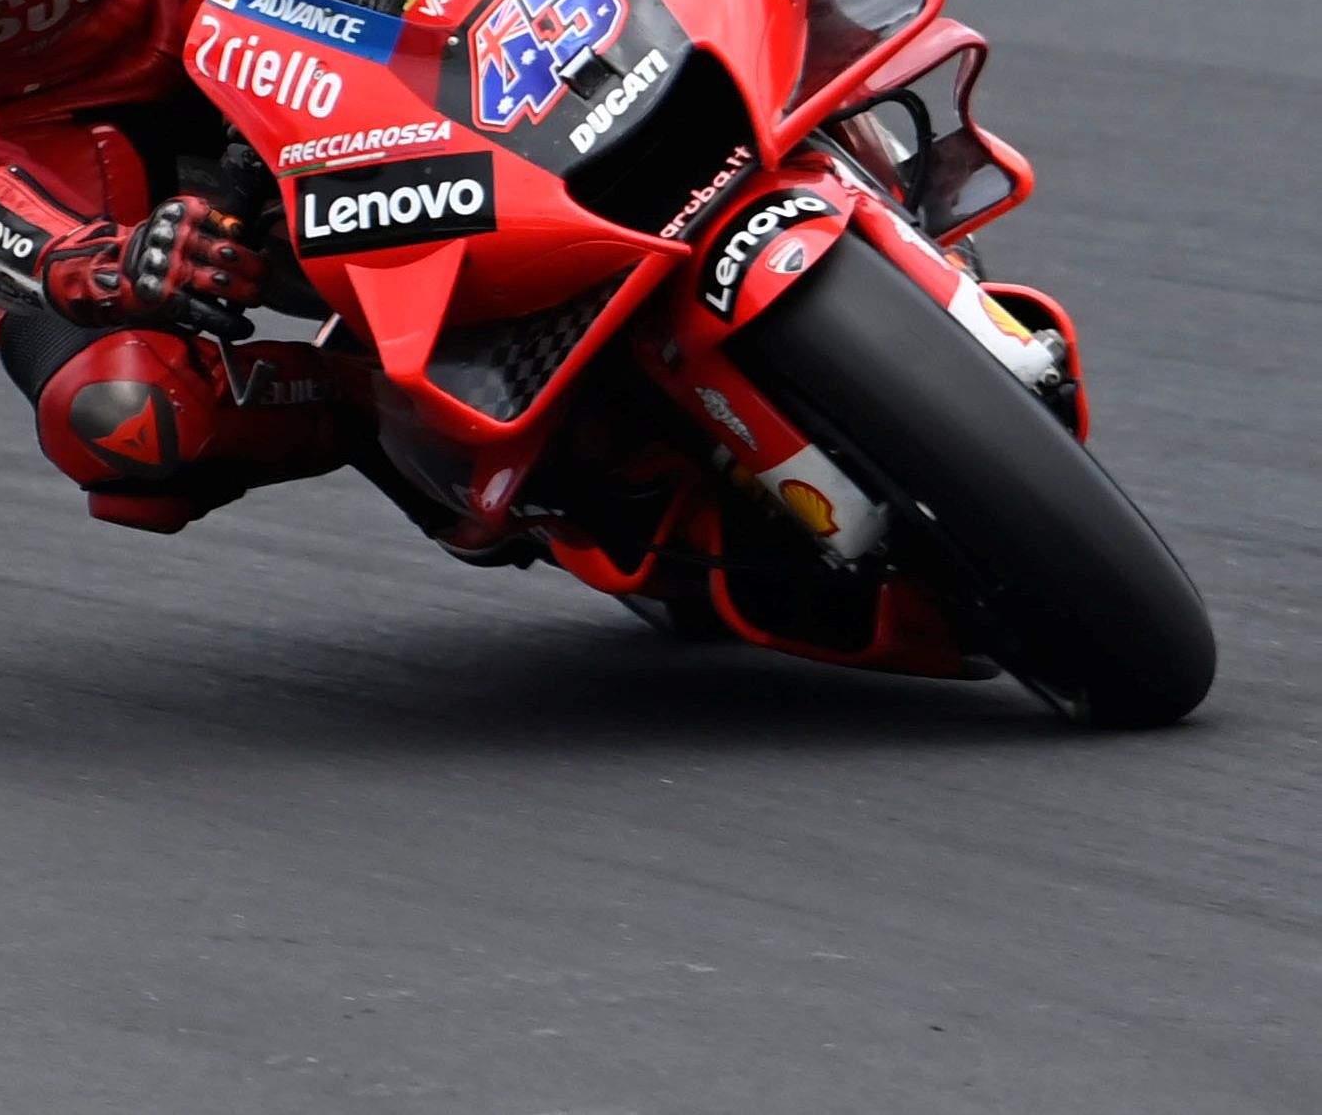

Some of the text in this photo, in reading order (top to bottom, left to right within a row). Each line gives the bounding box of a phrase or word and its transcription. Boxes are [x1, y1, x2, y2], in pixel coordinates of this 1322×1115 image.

[277, 119, 454, 168] FRECCIAROSSA
[568, 49, 670, 155] DUCATI
[303, 178, 485, 239] Lenovo
[705, 195, 830, 313] Lenovo
